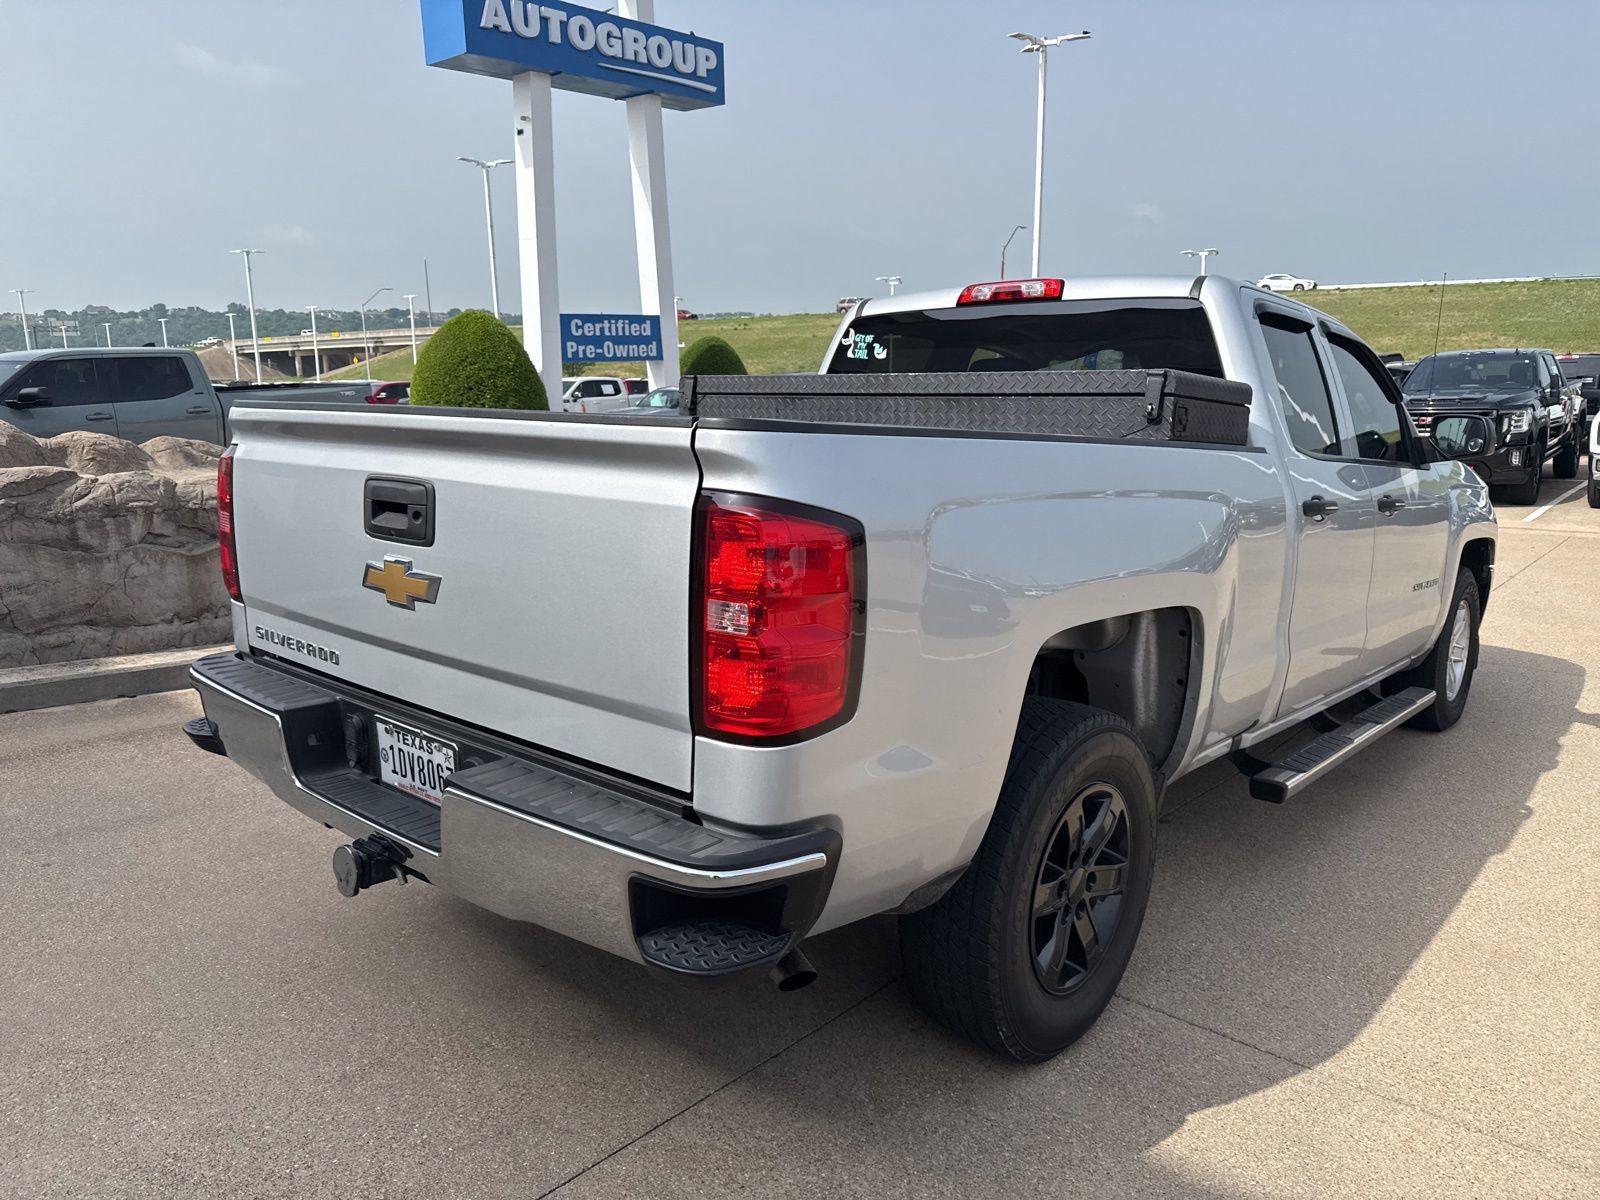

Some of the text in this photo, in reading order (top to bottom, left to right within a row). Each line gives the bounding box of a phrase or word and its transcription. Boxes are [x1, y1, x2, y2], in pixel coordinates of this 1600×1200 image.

[480, 0, 718, 78] AUTOGROUP
[570, 319, 651, 336] Certified
[855, 333, 875, 343] GET OFF
[566, 341, 657, 358] Pre-Owned
[854, 349, 869, 359] TAIL
[255, 625, 340, 666] SILVERADO
[394, 729, 434, 755] TEXAS
